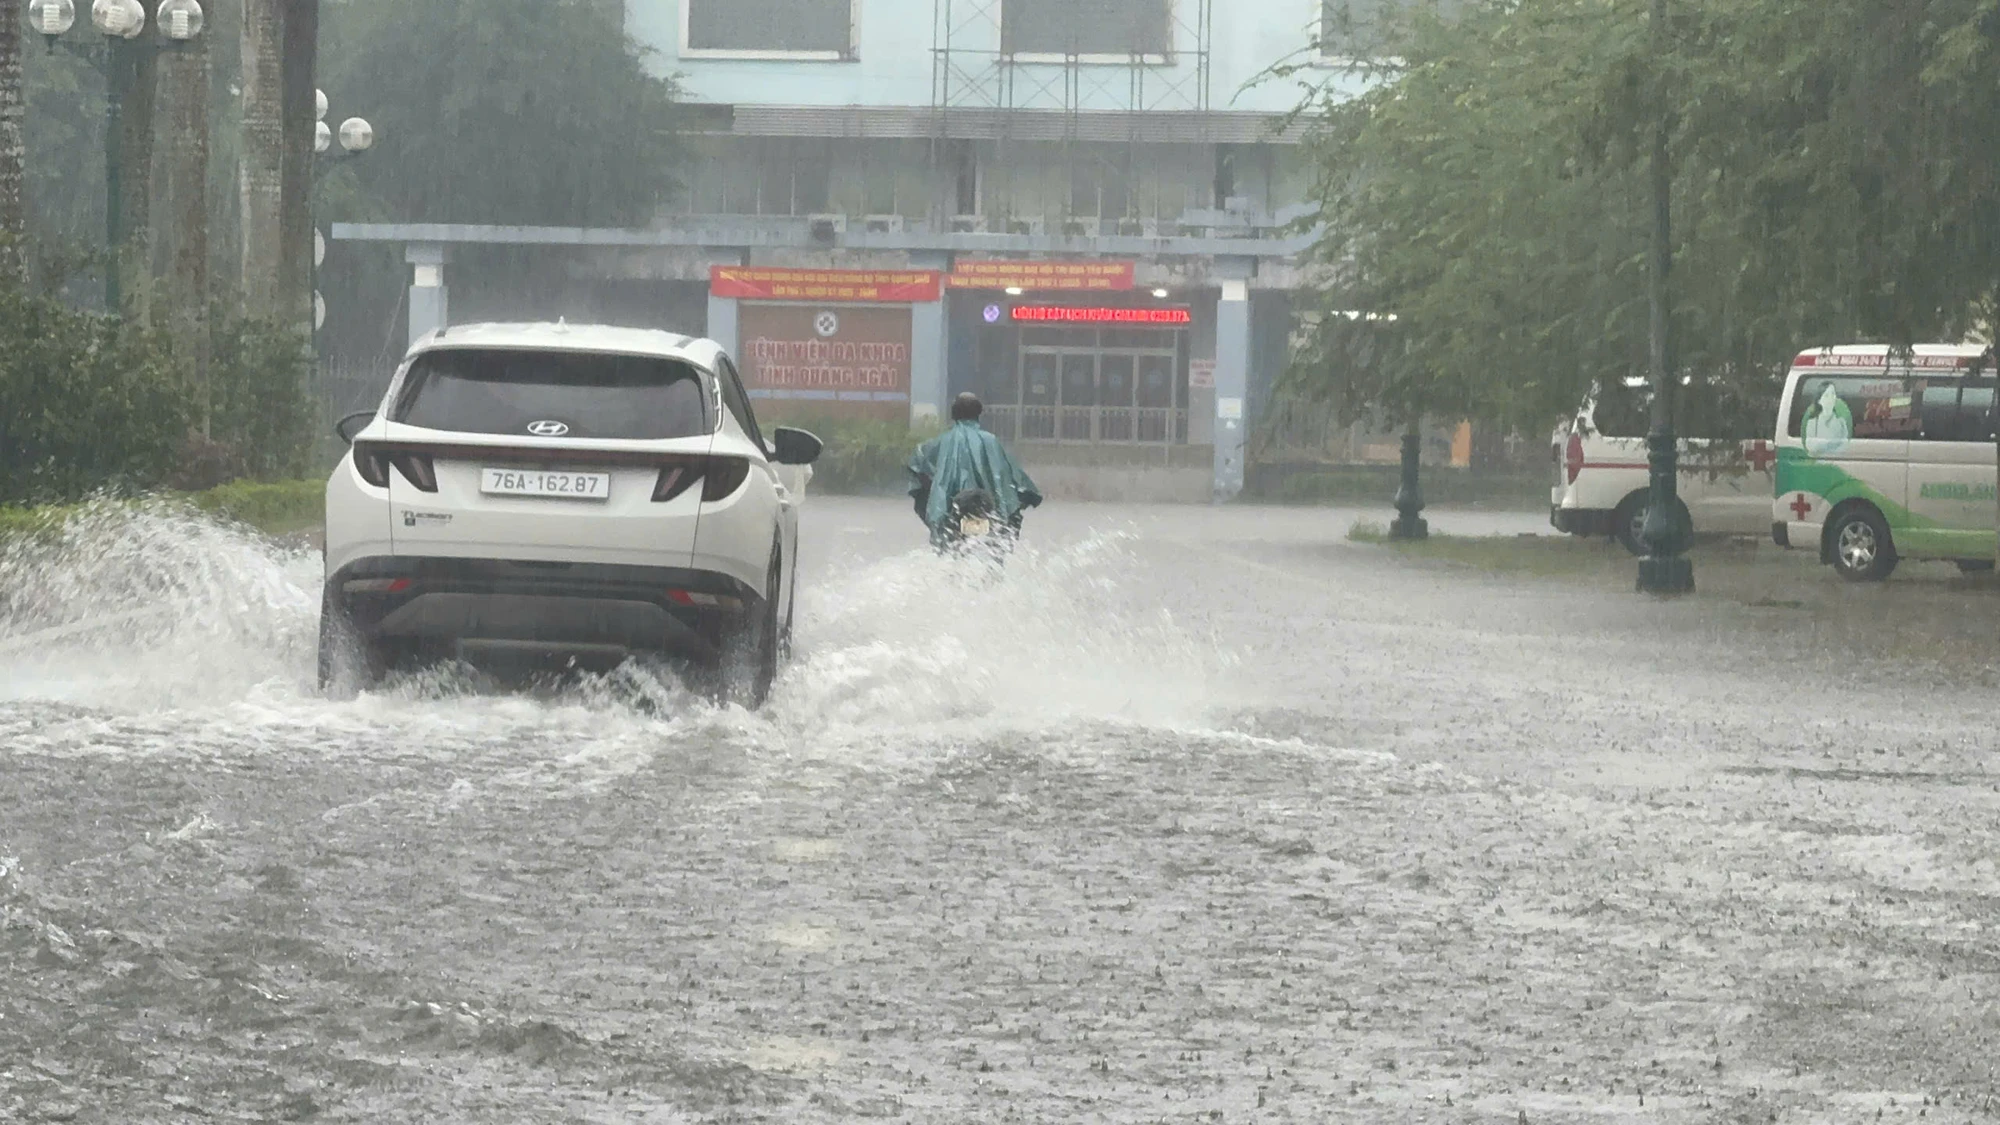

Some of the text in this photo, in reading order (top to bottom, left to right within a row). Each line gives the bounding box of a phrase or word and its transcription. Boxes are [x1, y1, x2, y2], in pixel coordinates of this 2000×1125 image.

[792, 338, 829, 363] VIỆN
[859, 342, 907, 362] KHOA
[799, 361, 853, 386] QUẢNG
[492, 472, 600, 493] 76A-162.87
